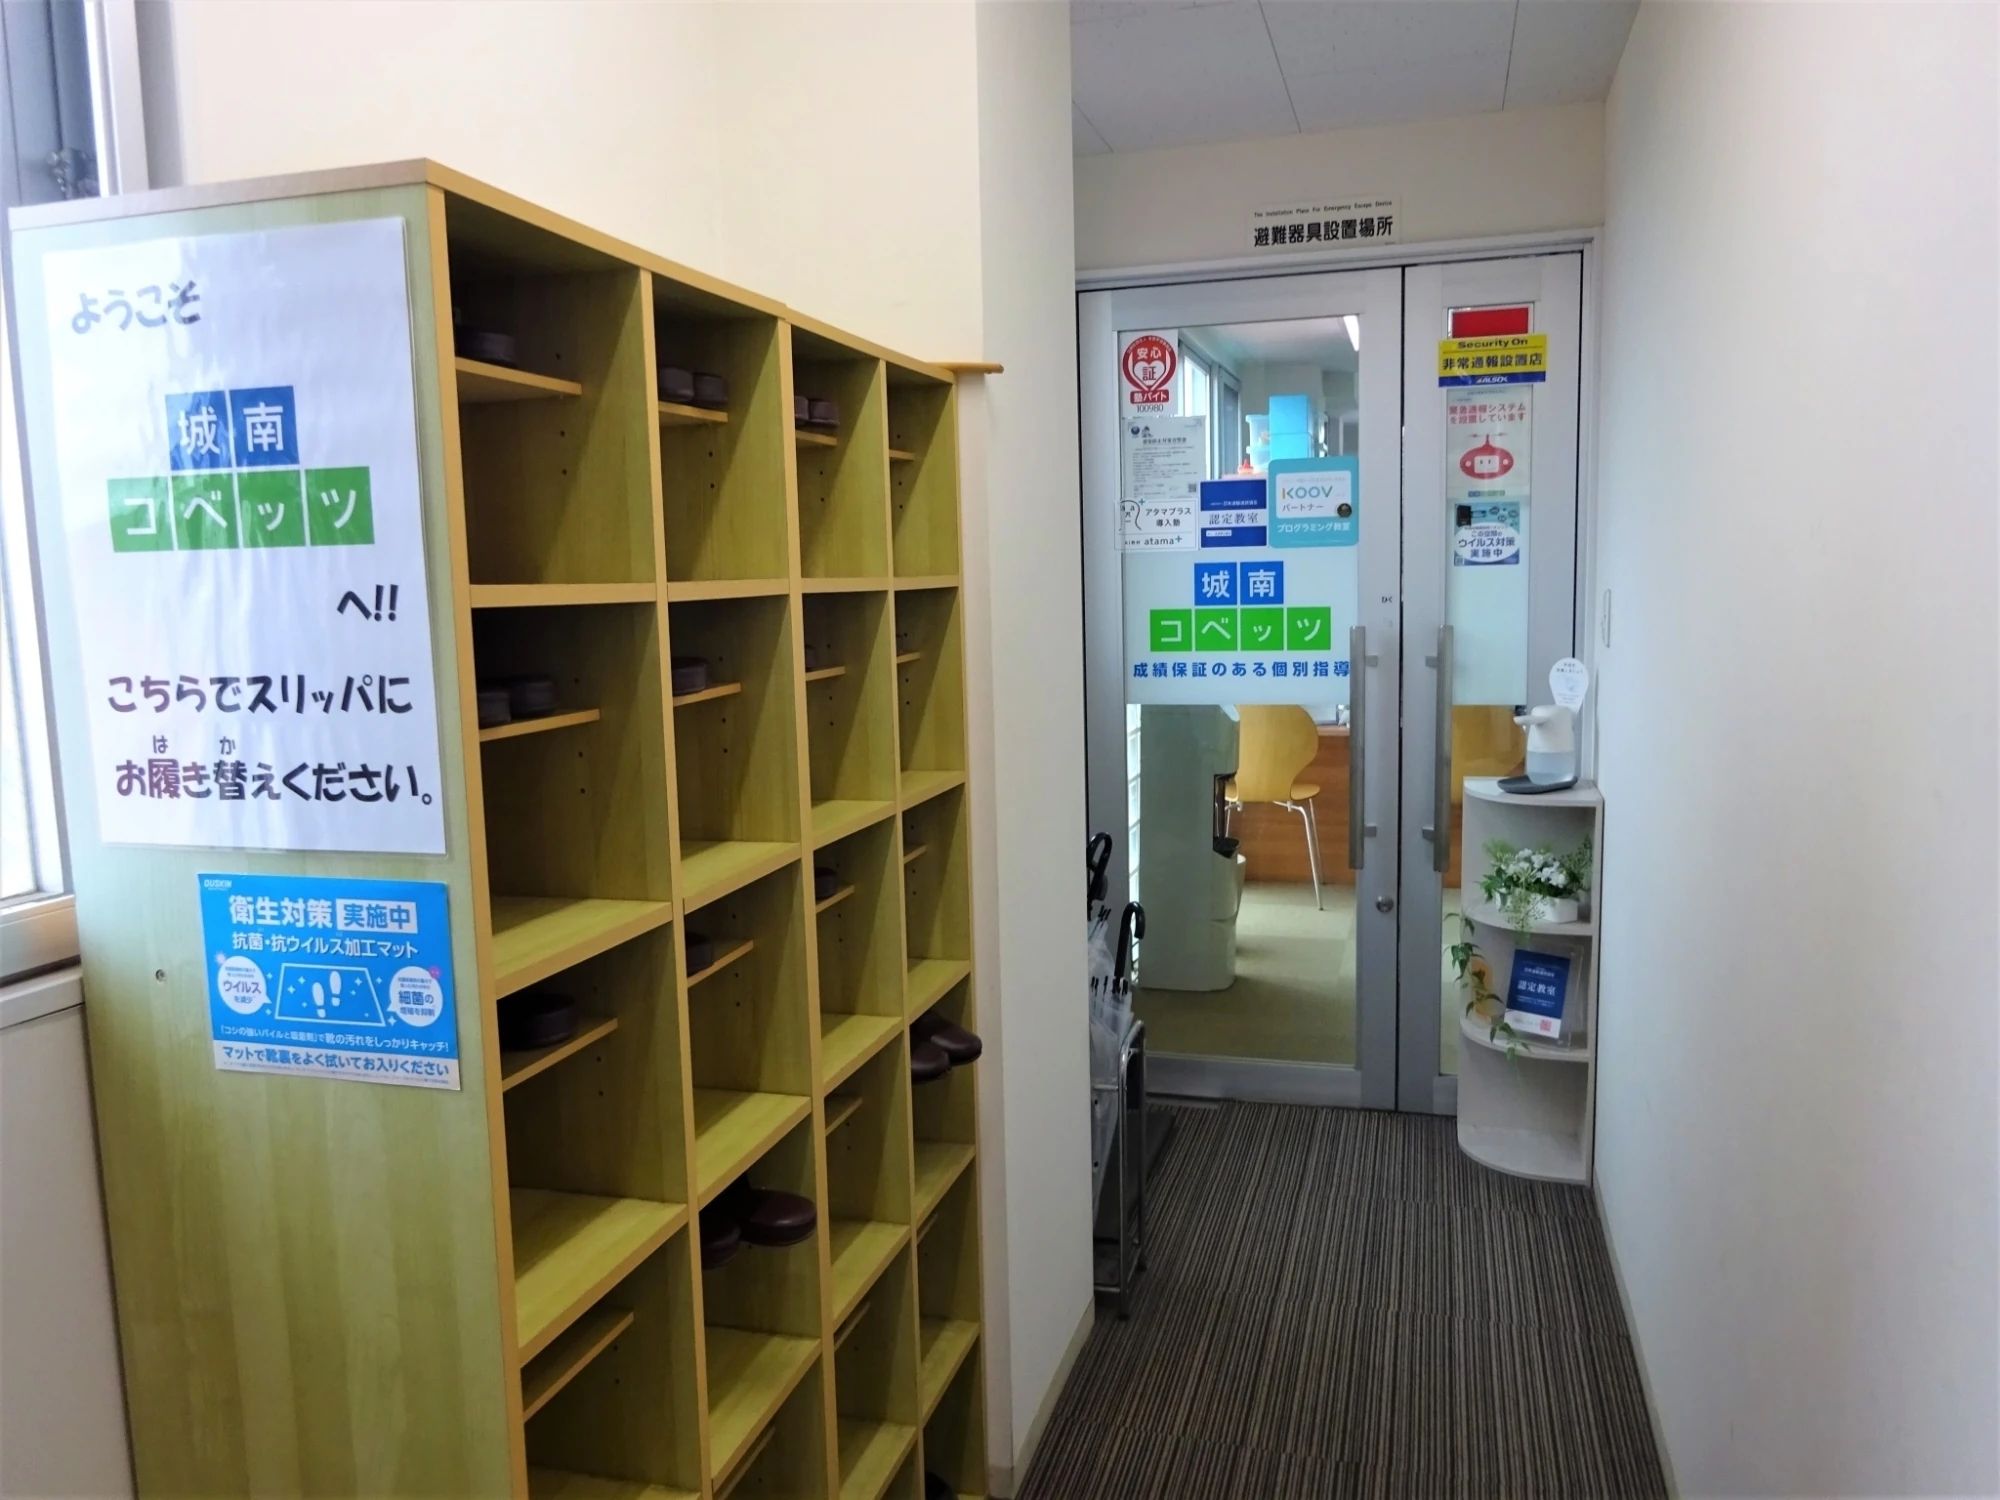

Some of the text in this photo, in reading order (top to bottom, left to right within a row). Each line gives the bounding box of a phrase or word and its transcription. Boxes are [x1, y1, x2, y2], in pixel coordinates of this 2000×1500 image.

[1254, 216, 1393, 247] 避難器具設置場所
[71, 280, 201, 334] ようこそ
[1137, 347, 1161, 360] 安心
[1457, 337, 1528, 349] Security On
[1142, 366, 1156, 381] 証
[1443, 352, 1543, 370] 非常通報設置店
[177, 401, 284, 456] 城南
[1282, 486, 1333, 499] KOOV
[124, 488, 357, 535] コベッツ
[1201, 570, 1276, 598] 城南
[337, 584, 399, 622] へ!!
[1160, 617, 1321, 643] コベッツ
[1133, 661, 1350, 678] 成績保証のある個別指導
[108, 674, 413, 714] こちらでスリッパに
[152, 736, 236, 755] は か
[116, 758, 432, 806] お履き替えください。
[228, 895, 411, 930] 衛生対策 実施中
[232, 932, 418, 959] 抗菌・抗ウイルス加工マット
[223, 980, 262, 994] ウイルス
[223, 1046, 449, 1076] マットで靴裏をよく拭いてお入りください
